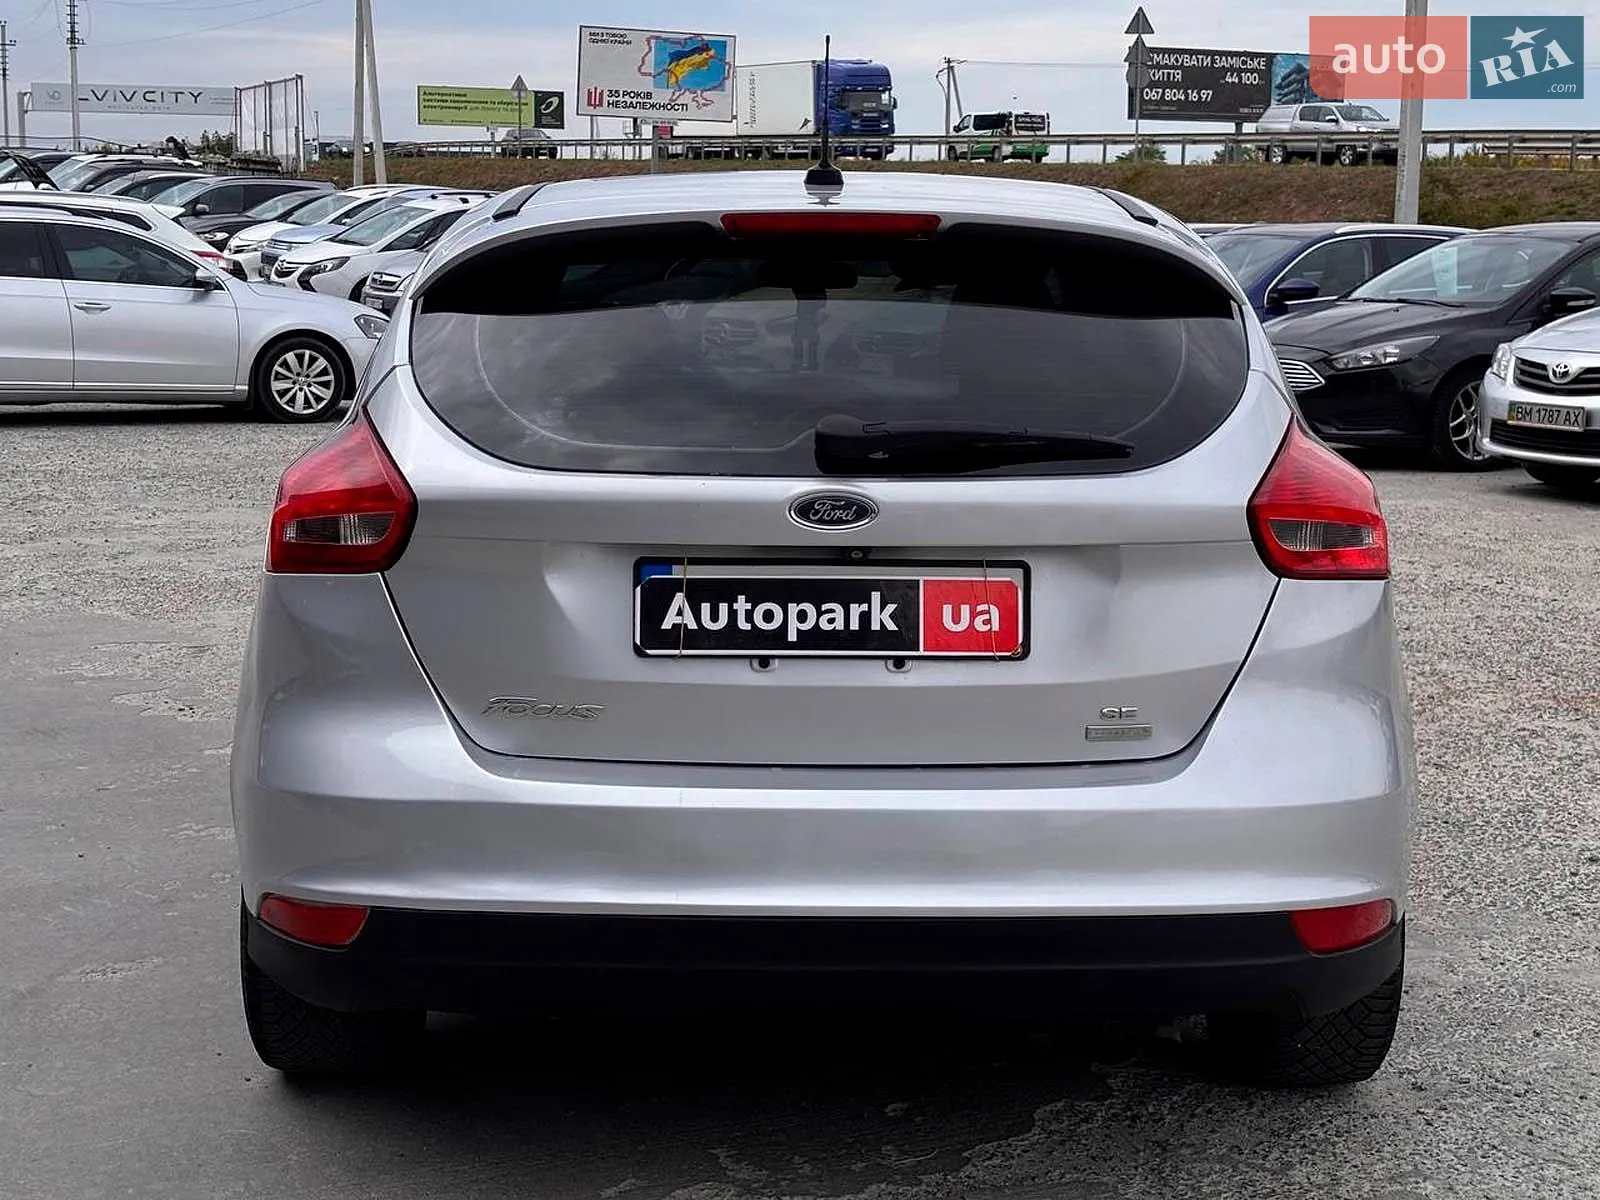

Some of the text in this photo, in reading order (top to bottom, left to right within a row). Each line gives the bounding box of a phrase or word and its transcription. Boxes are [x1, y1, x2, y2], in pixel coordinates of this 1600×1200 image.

[1213, 55, 1267, 69] ЗАМІСЬКЕ
[1225, 72, 1239, 84] 44
[1241, 72, 1259, 85] 100
[607, 89, 653, 100] 35 РОКІВ
[1143, 88, 1213, 102] 067 804 16 97
[607, 99, 688, 112] НЕЗАЛЕЖНОСТІ
[1516, 406, 1581, 426] BM 1787 AX
[810, 499, 857, 520] Ford
[661, 591, 1000, 641] Autopark ua
[1100, 705, 1138, 720] SE
